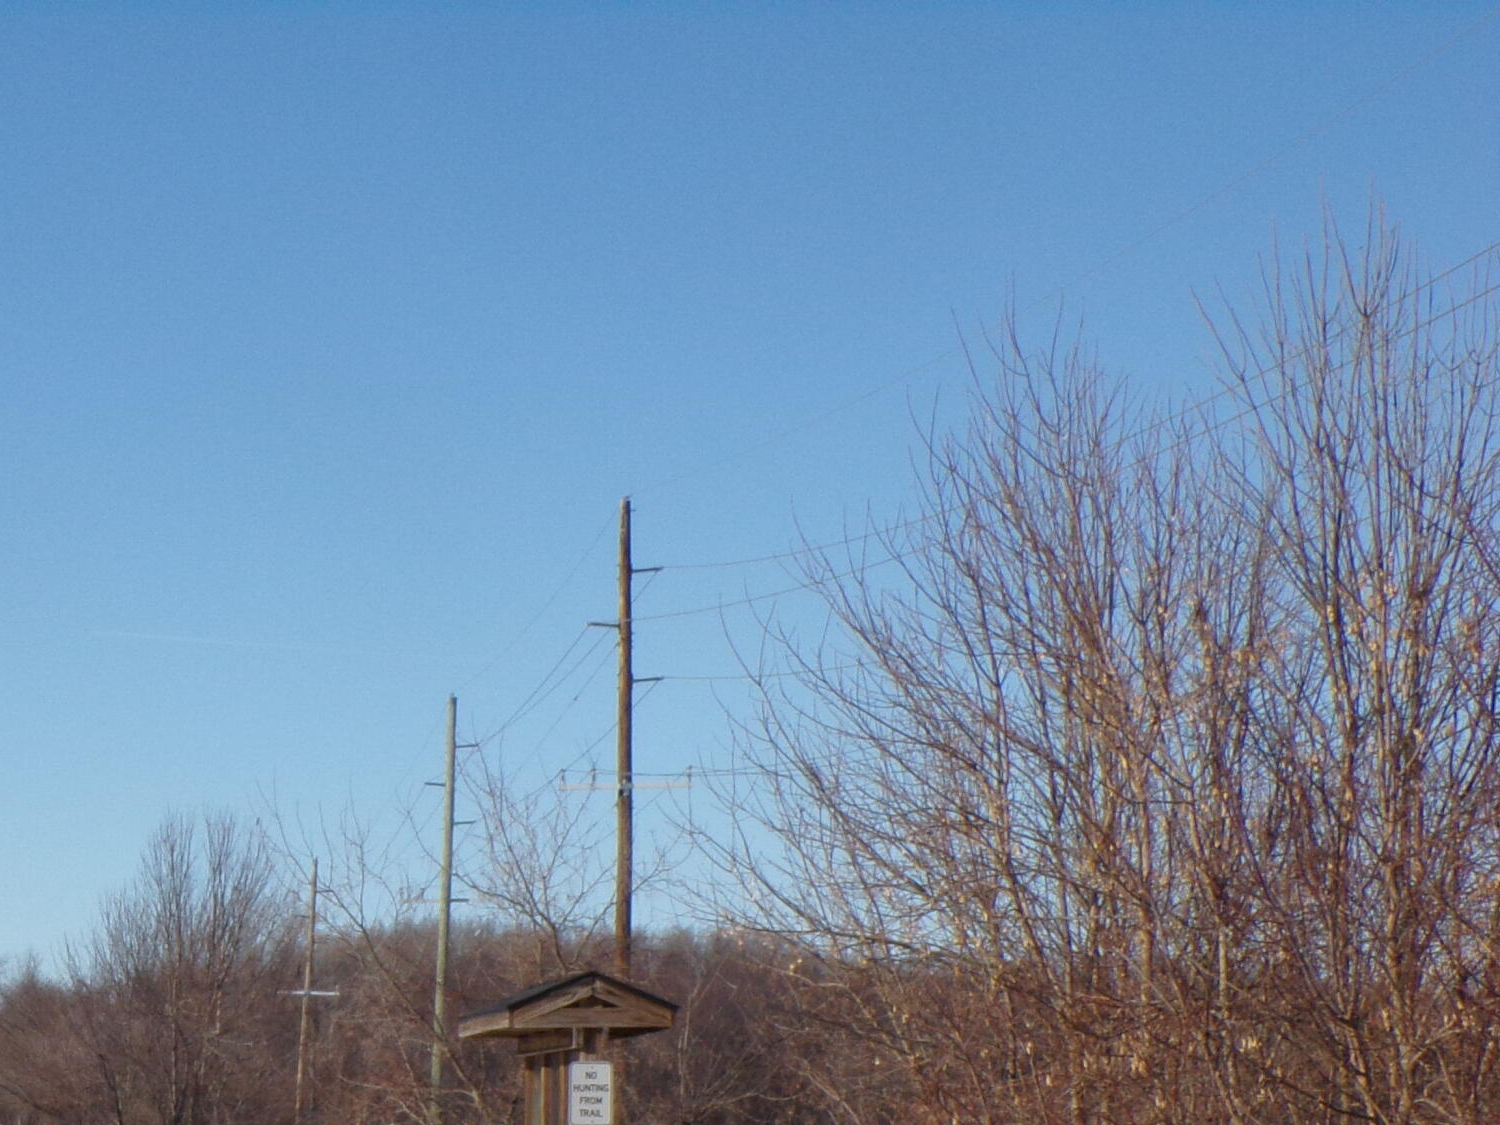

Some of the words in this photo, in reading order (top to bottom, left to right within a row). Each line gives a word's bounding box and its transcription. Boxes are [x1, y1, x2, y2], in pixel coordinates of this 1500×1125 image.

[585, 1071, 597, 1080] NO
[573, 1084, 609, 1092] HUNTING
[580, 1096, 603, 1104] FROM
[580, 1109, 603, 1117] TRAIL
